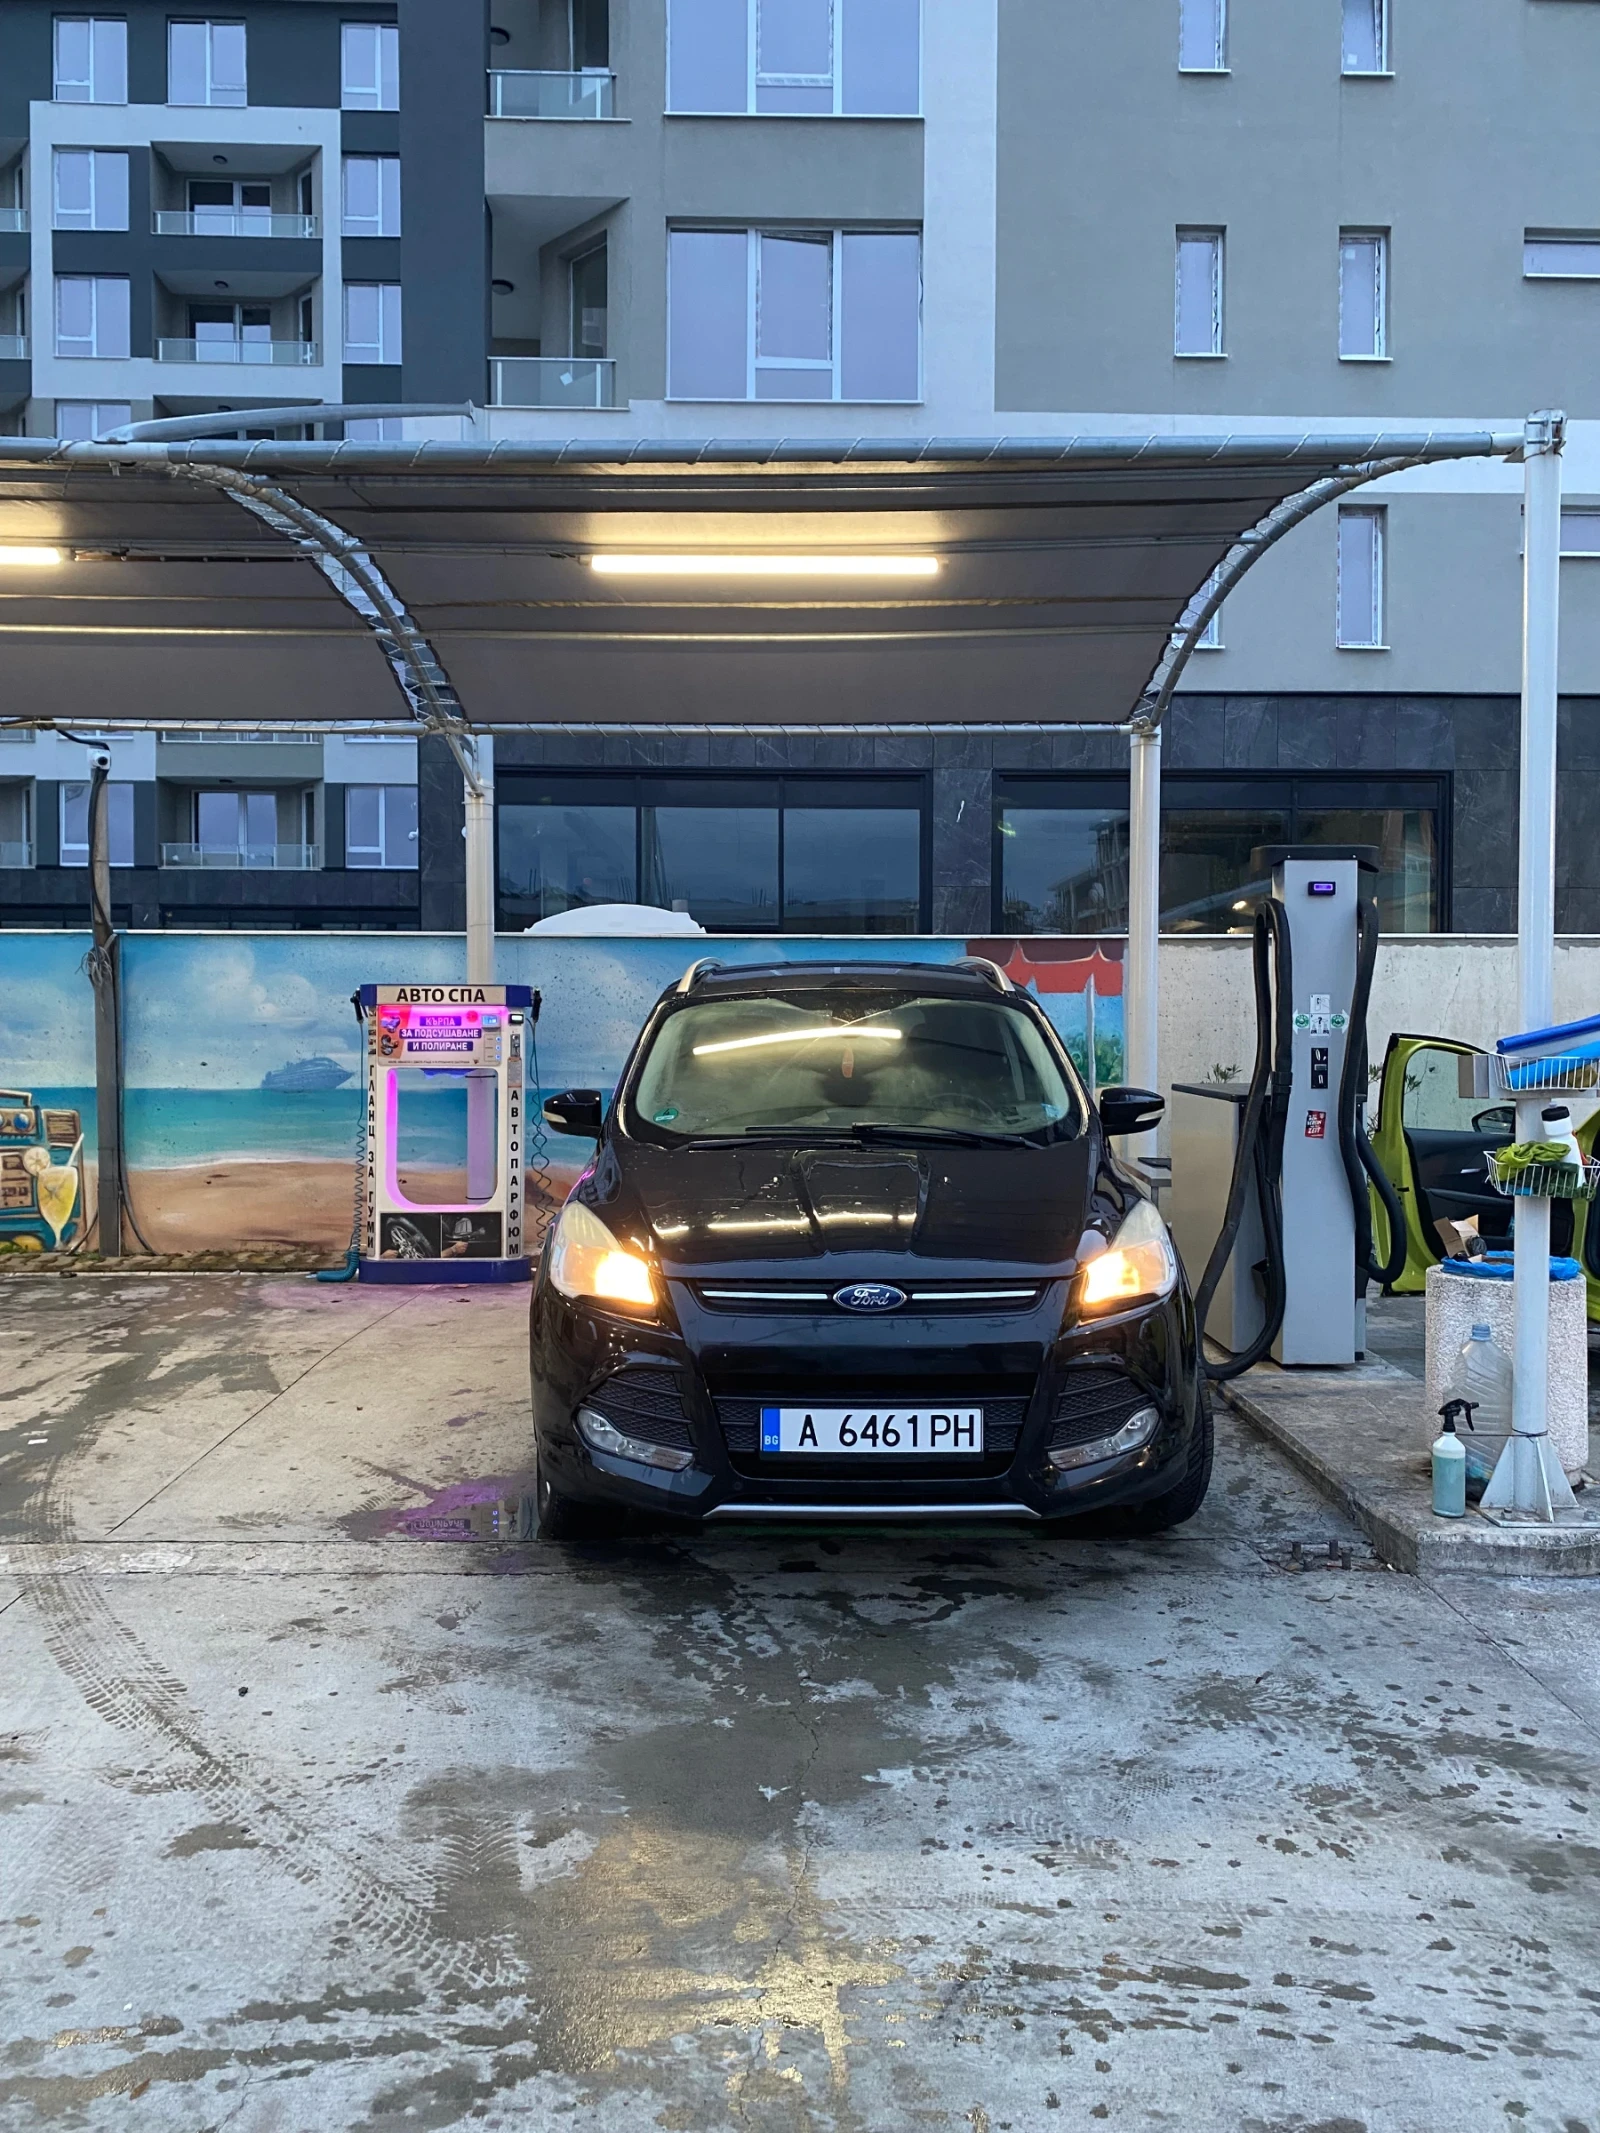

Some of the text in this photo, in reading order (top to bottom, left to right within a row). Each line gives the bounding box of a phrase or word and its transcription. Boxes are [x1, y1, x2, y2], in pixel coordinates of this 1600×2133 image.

[396, 988, 485, 1003] АВТО СПА
[425, 1017, 455, 1026] КЪРПА
[401, 1029, 479, 1038] ЗА ПОДСУШАВАНЕ
[412, 1042, 468, 1051] И ПОЛИРАНЕ
[367, 1150, 374, 1178] ЗА
[507, 1089, 520, 1255] АВТОПАРФЮМ
[366, 1191, 374, 1248] ГУМИ
[850, 1288, 890, 1305] Ford
[798, 1414, 975, 1447] A 6461 PH
[764, 1435, 779, 1445] BG
